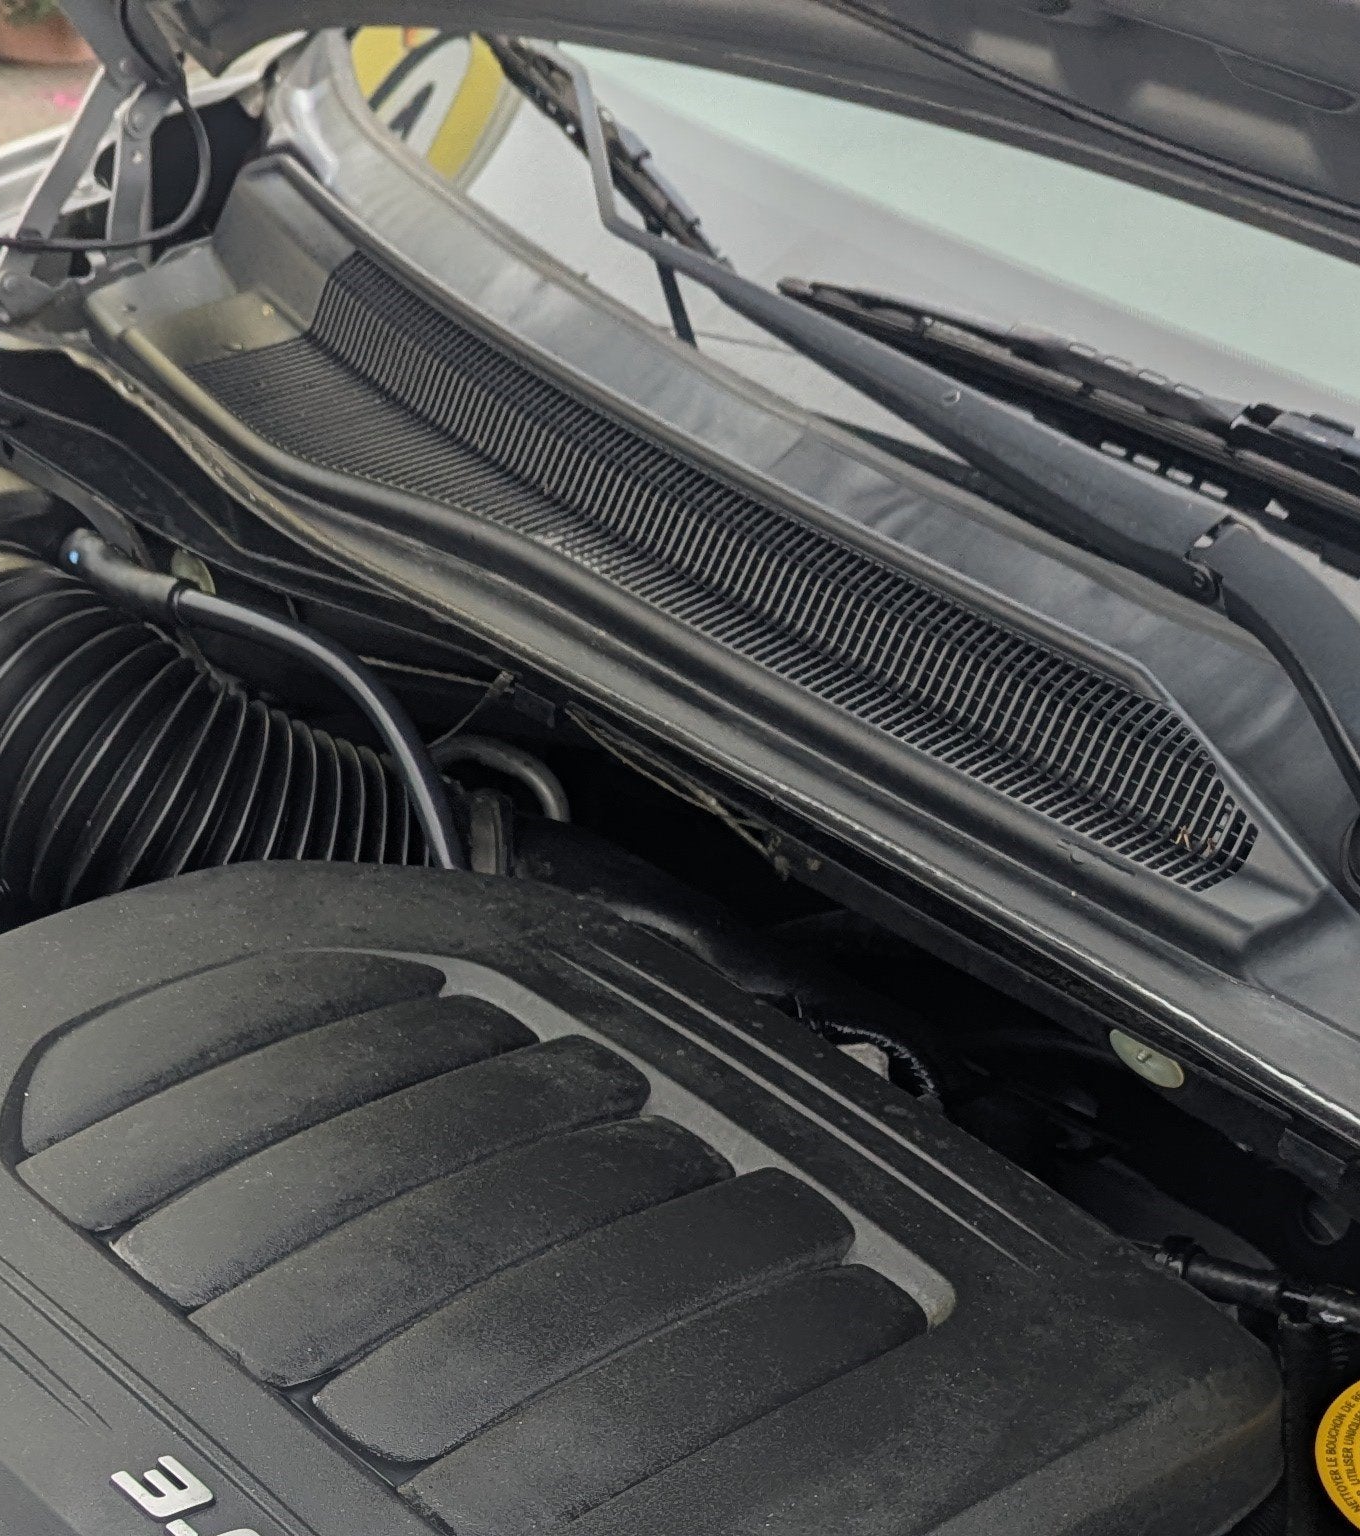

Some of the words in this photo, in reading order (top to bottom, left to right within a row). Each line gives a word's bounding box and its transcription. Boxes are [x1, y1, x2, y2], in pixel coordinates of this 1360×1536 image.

[1342, 1402, 1355, 1411] DE
[1326, 1413, 1346, 1451] BOUCHON
[1326, 1456, 1338, 1467] LE
